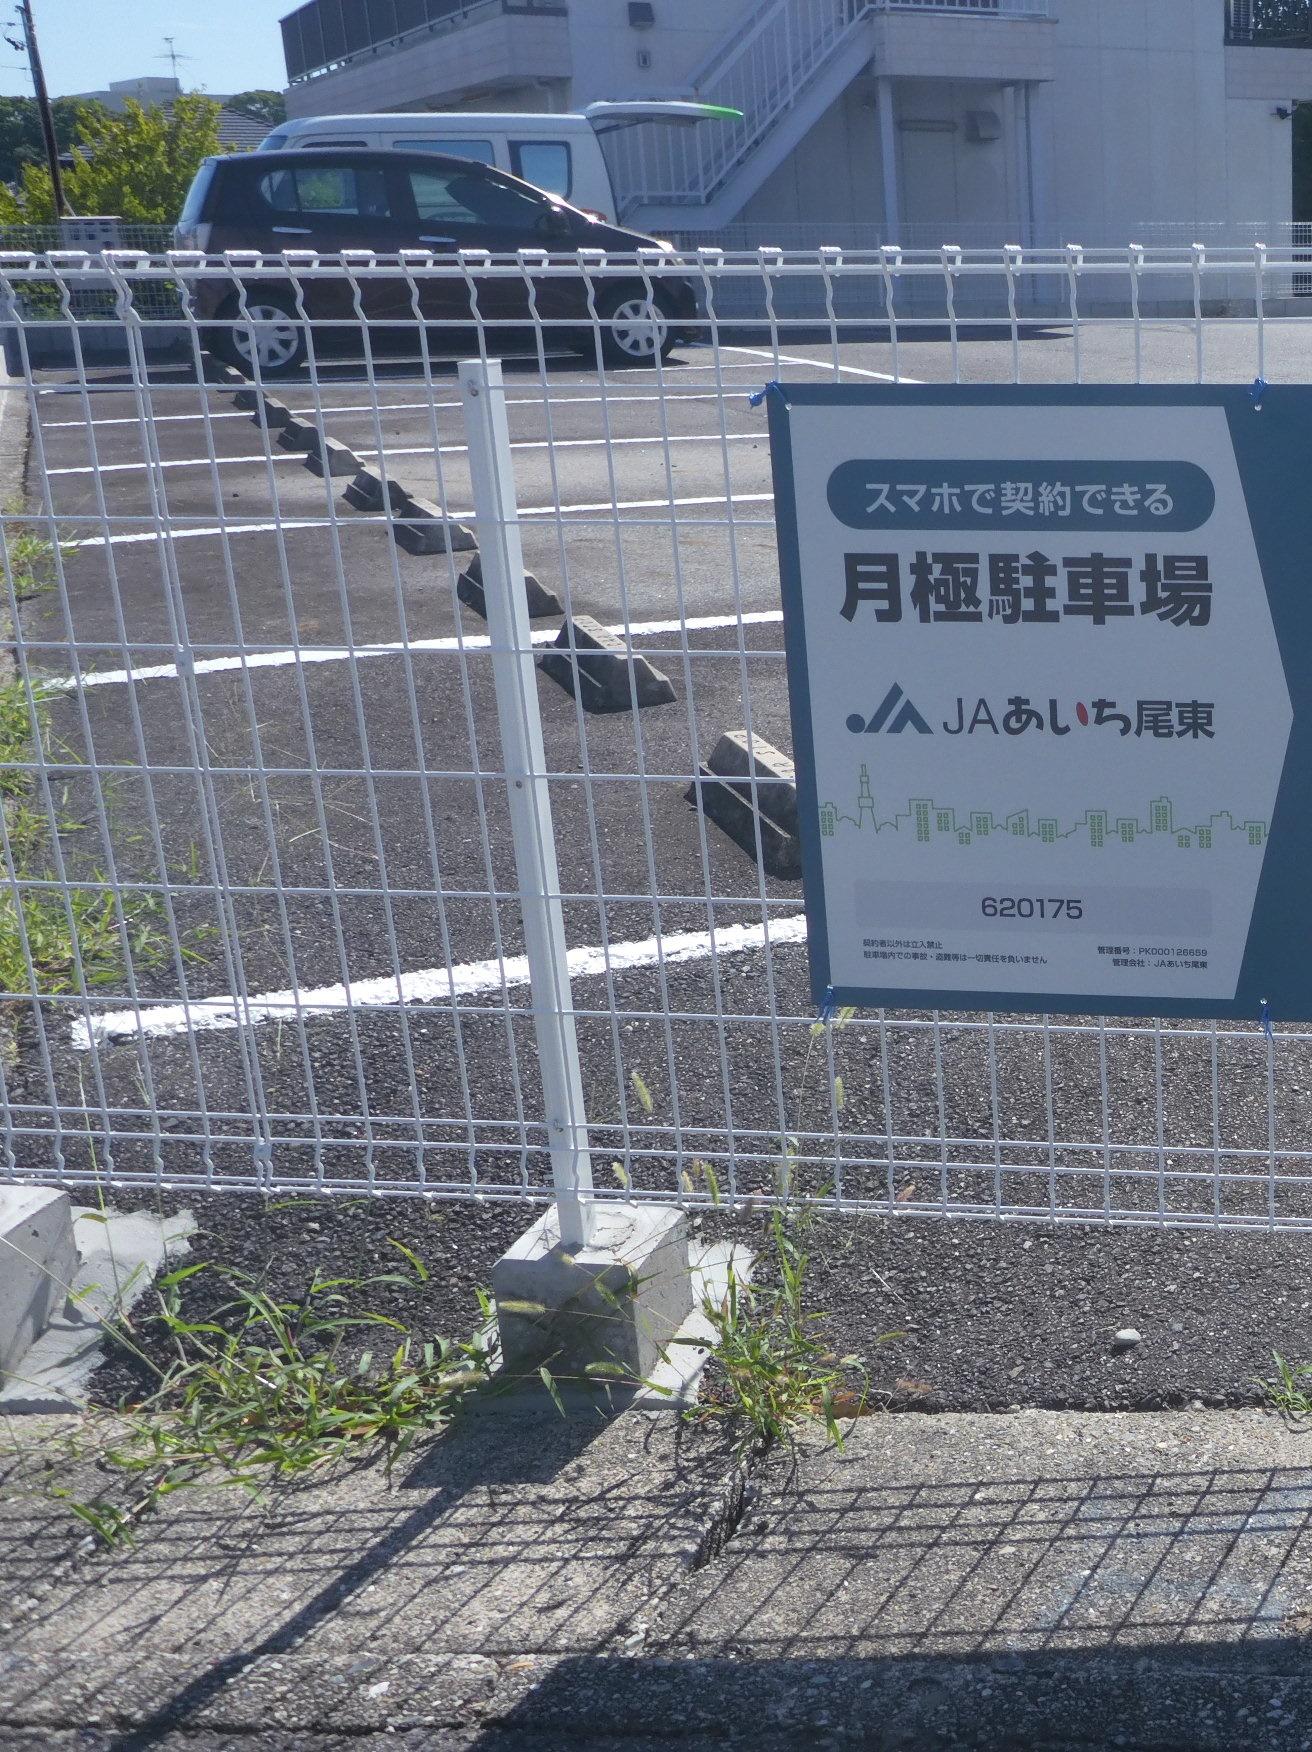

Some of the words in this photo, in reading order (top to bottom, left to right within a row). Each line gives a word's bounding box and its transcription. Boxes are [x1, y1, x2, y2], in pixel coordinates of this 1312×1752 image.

[864, 482, 1175, 516] スマホで契約できる
[840, 550, 1214, 627] 月極駐車場
[942, 696, 1216, 739] JAあいち尾東
[981, 897, 1083, 920] 620175
[862, 939, 944, 950] 契約者以外は立入禁止
